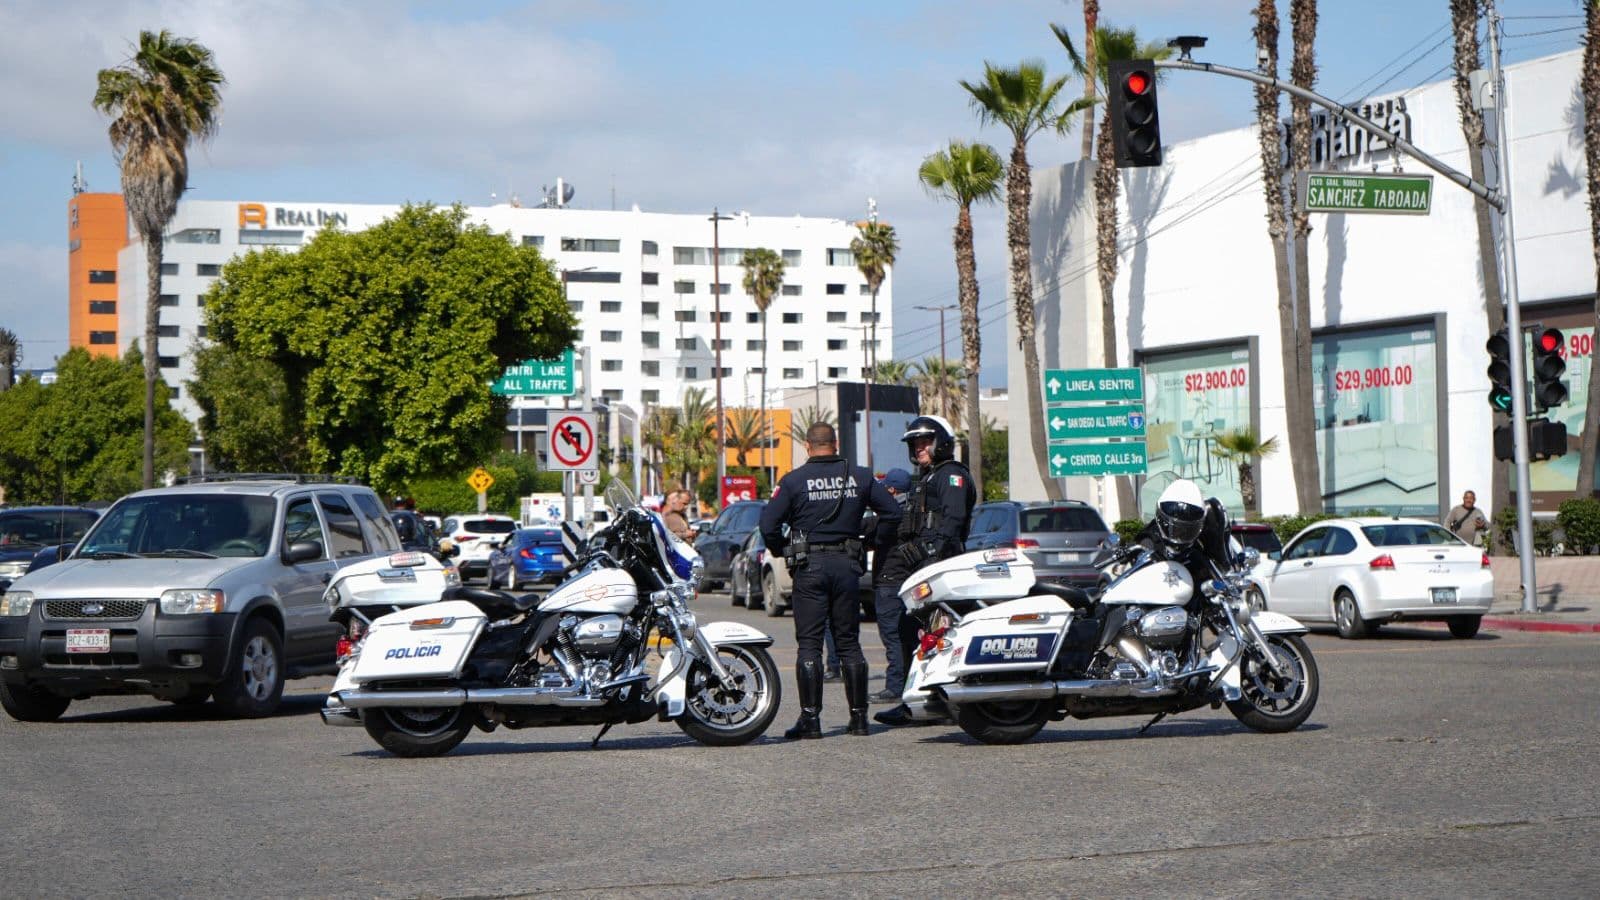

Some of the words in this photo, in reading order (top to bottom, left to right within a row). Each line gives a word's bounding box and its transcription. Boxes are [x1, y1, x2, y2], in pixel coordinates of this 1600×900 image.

[1279, 112, 1413, 168] Bnanza
[1309, 187, 1366, 207] SANCHEZ
[1373, 189, 1427, 209] TABOADA
[505, 365, 533, 376] ENTRI
[541, 365, 566, 377] LANE
[1335, 365, 1412, 391] $29,900.00
[503, 379, 522, 390] ALL
[529, 379, 567, 390] TRAFFIC
[1066, 380, 1095, 391] LINEA
[1099, 379, 1134, 390] SENTRI
[1185, 368, 1245, 393] $12,900.00
[1067, 417, 1078, 428] SAN
[1079, 417, 1095, 428] DIEGO
[1096, 416, 1106, 427] ALL
[1106, 415, 1127, 427] TRAFFIC
[1070, 454, 1102, 466] CENTRO
[1104, 454, 1130, 465] CALLE
[384, 645, 442, 660] POLICIA
[980, 637, 1039, 655] POLICIA
